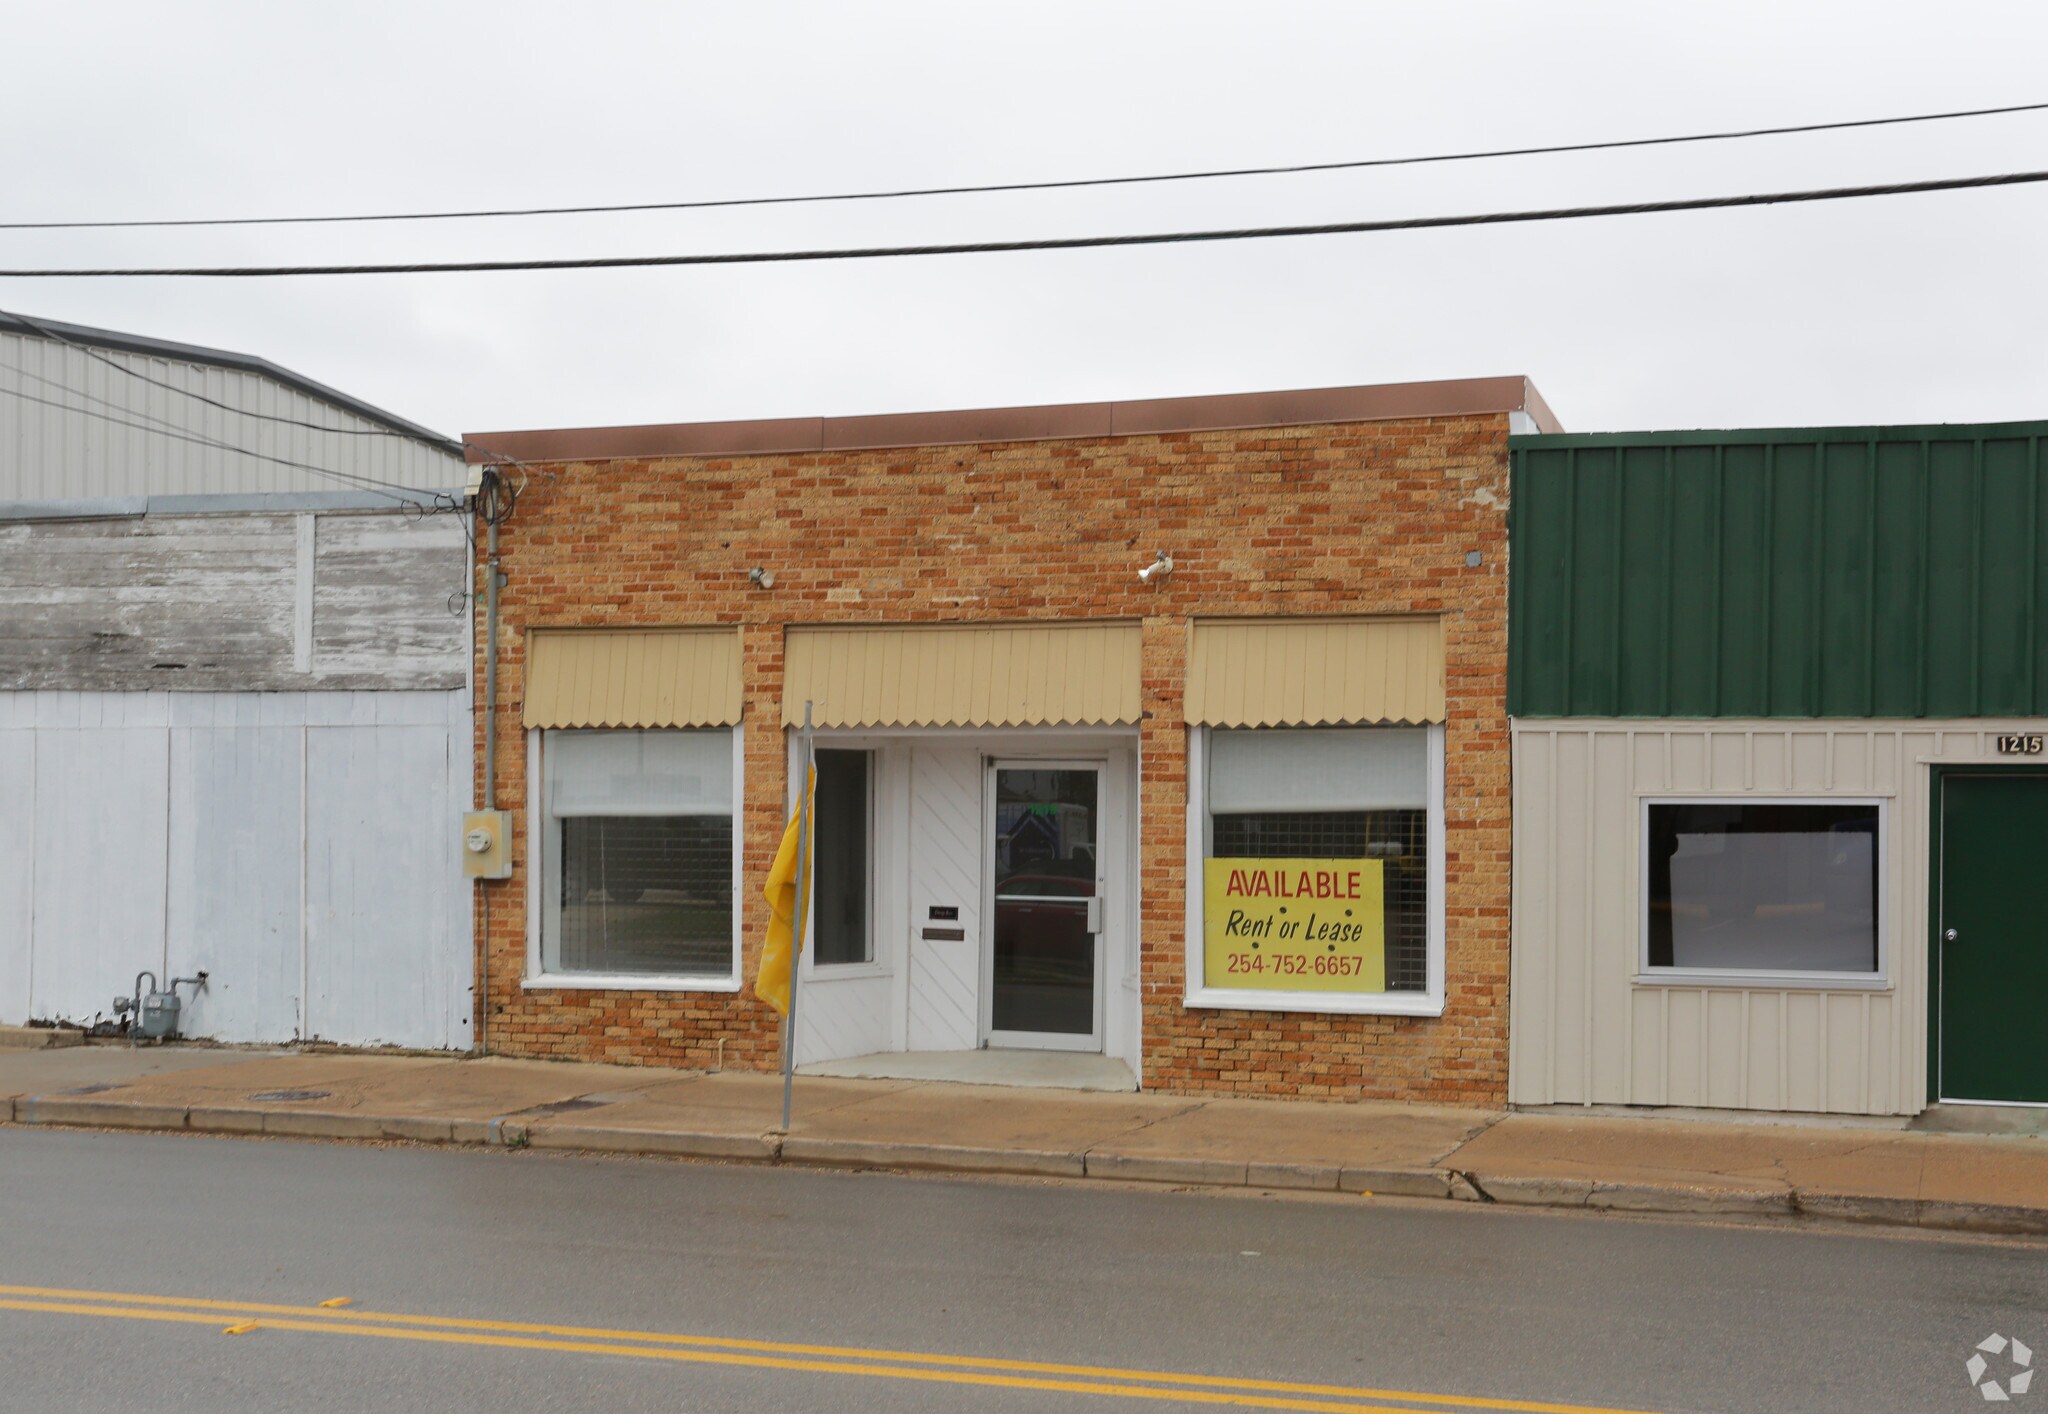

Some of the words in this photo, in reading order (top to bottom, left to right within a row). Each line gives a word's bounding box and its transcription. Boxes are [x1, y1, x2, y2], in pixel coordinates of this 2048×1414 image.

[2001, 736, 2042, 753] 1215
[1226, 870, 1361, 899] AVAILABLE
[1225, 909, 1273, 939] Rent
[1279, 923, 1299, 939] or
[1305, 913, 1362, 942] Lease
[1227, 954, 1363, 976] 254-752-6657
